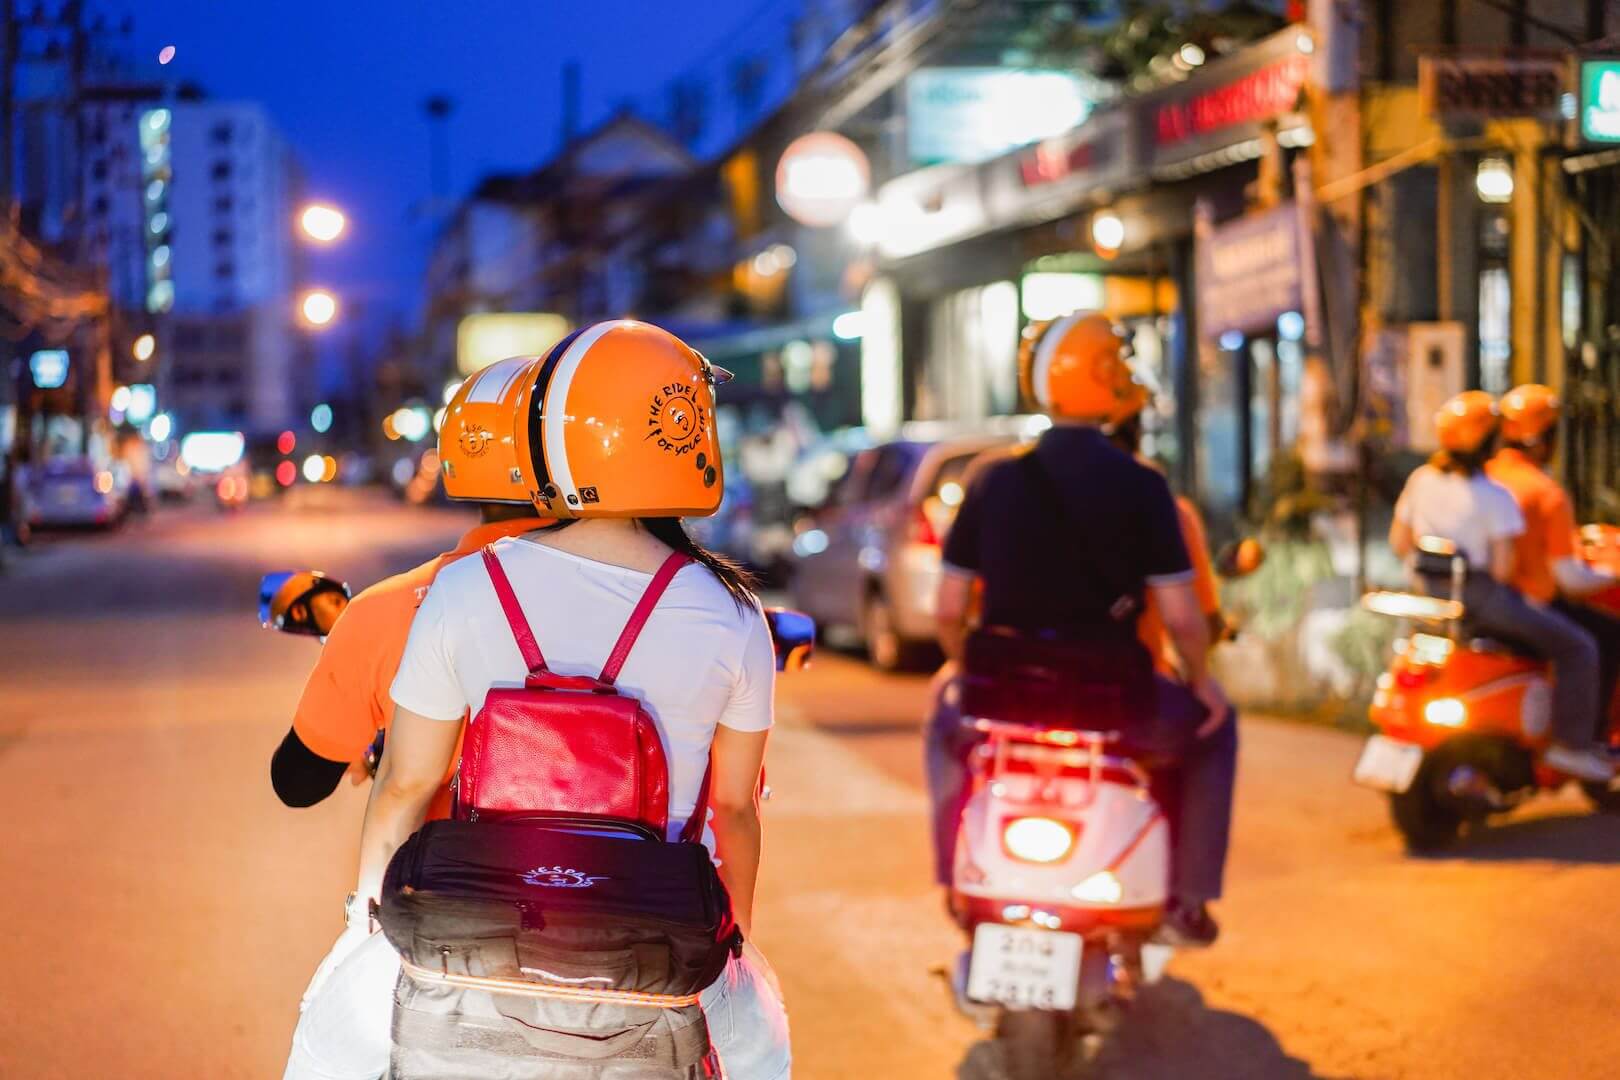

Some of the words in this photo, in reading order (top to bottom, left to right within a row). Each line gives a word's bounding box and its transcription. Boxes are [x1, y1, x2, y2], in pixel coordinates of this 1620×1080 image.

[648, 395, 664, 426] THE
[662, 383, 691, 396] RIDE
[657, 438, 674, 452] OF
[675, 434, 702, 457] YOUR
